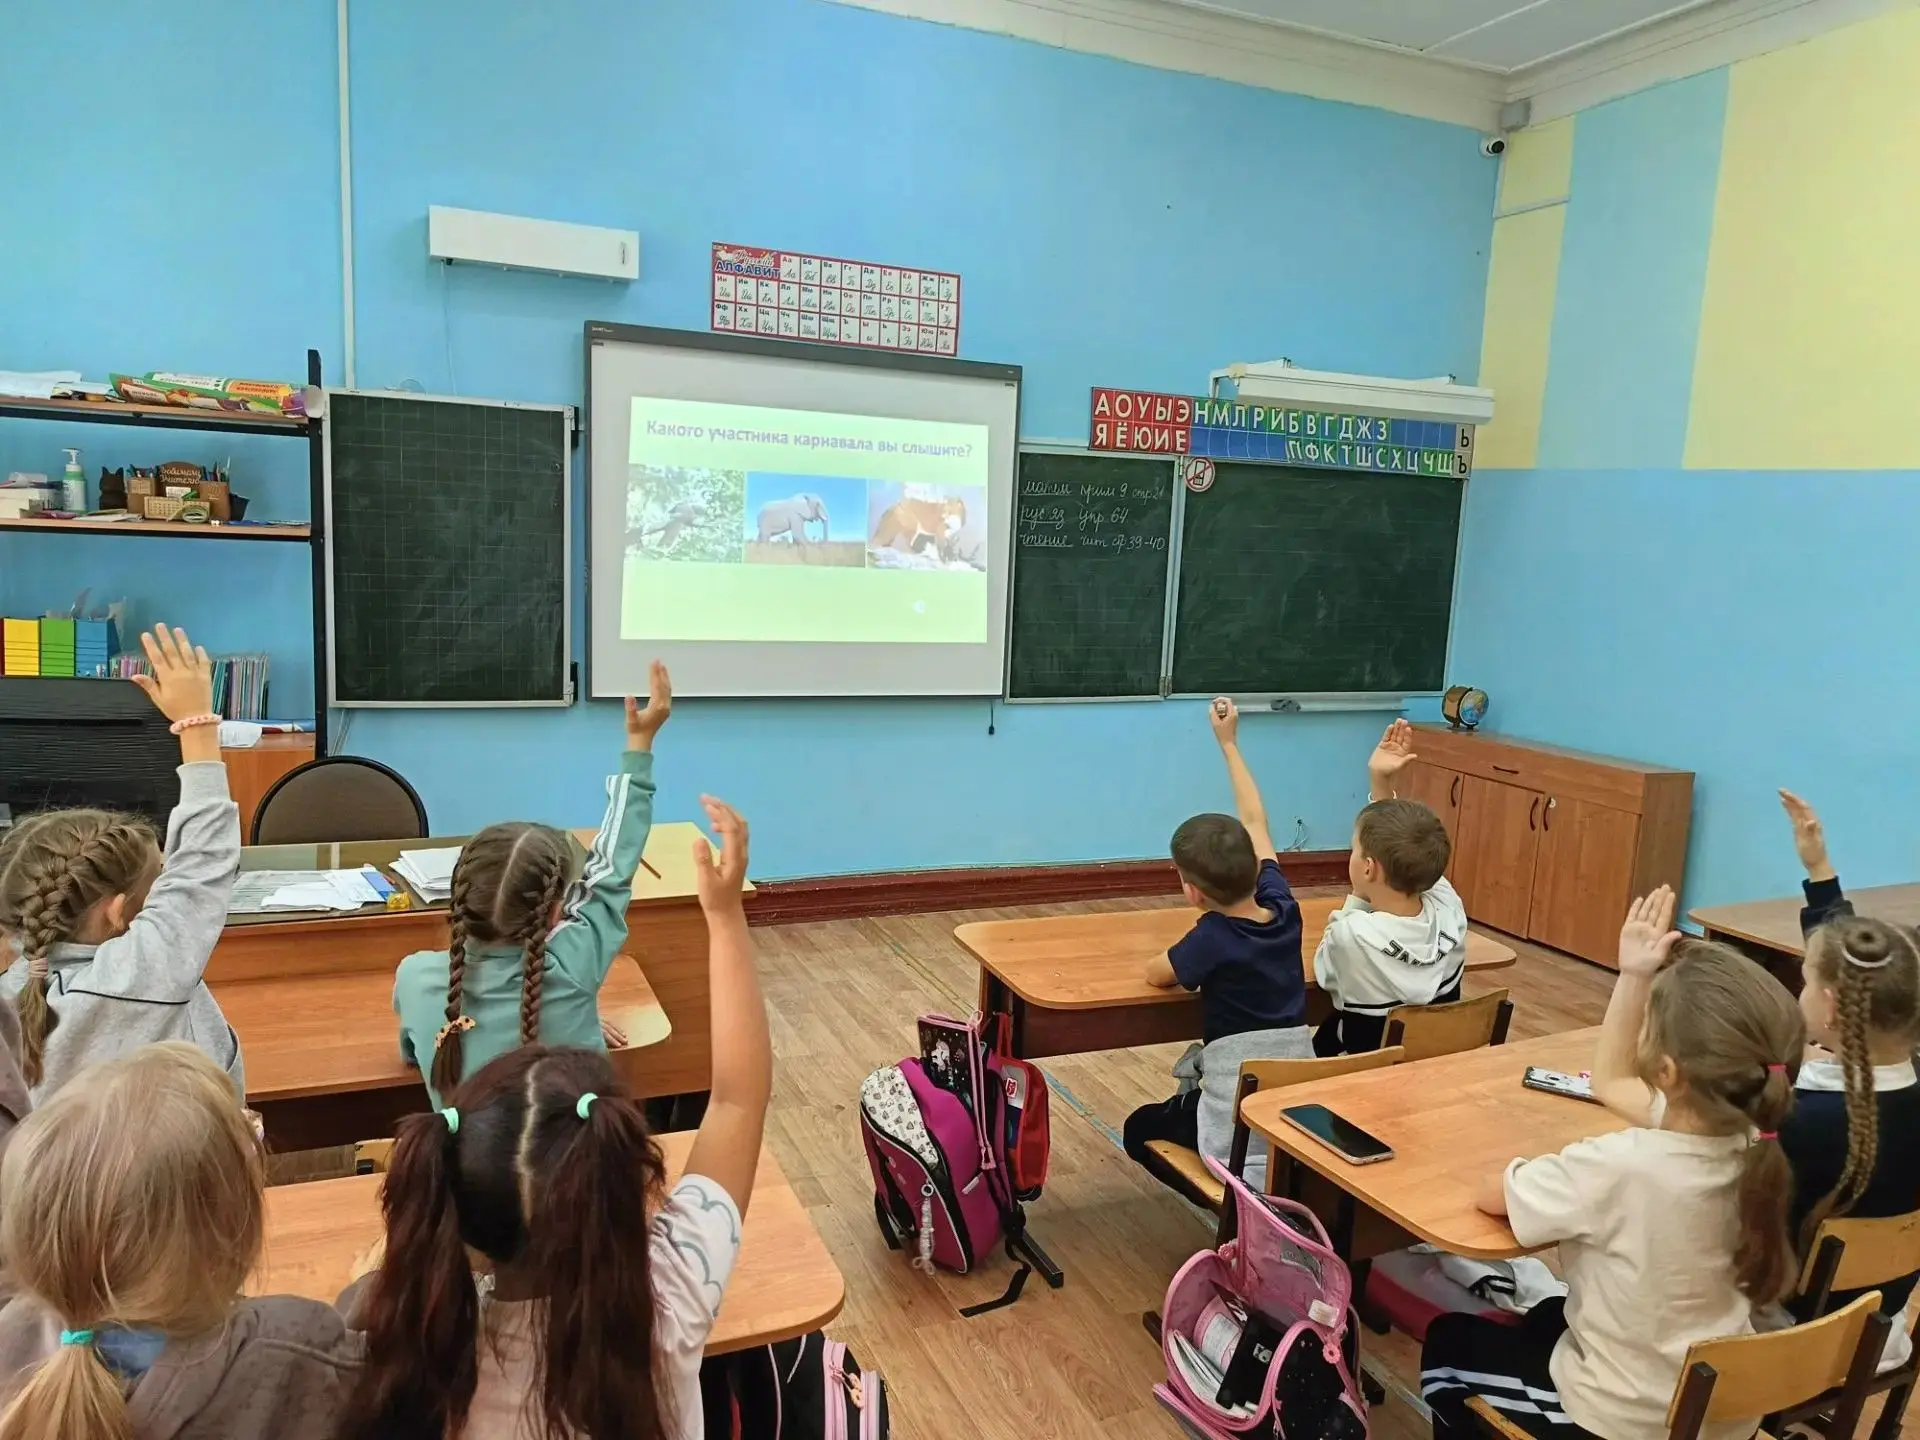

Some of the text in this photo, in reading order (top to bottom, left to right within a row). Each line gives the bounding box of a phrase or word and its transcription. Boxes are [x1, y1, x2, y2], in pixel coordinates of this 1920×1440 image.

[715, 260, 780, 278] АЛФАВИТ
[646, 419, 973, 457] Какого участника карнавала вы слышите?
[1120, 482, 1128, 498] 9
